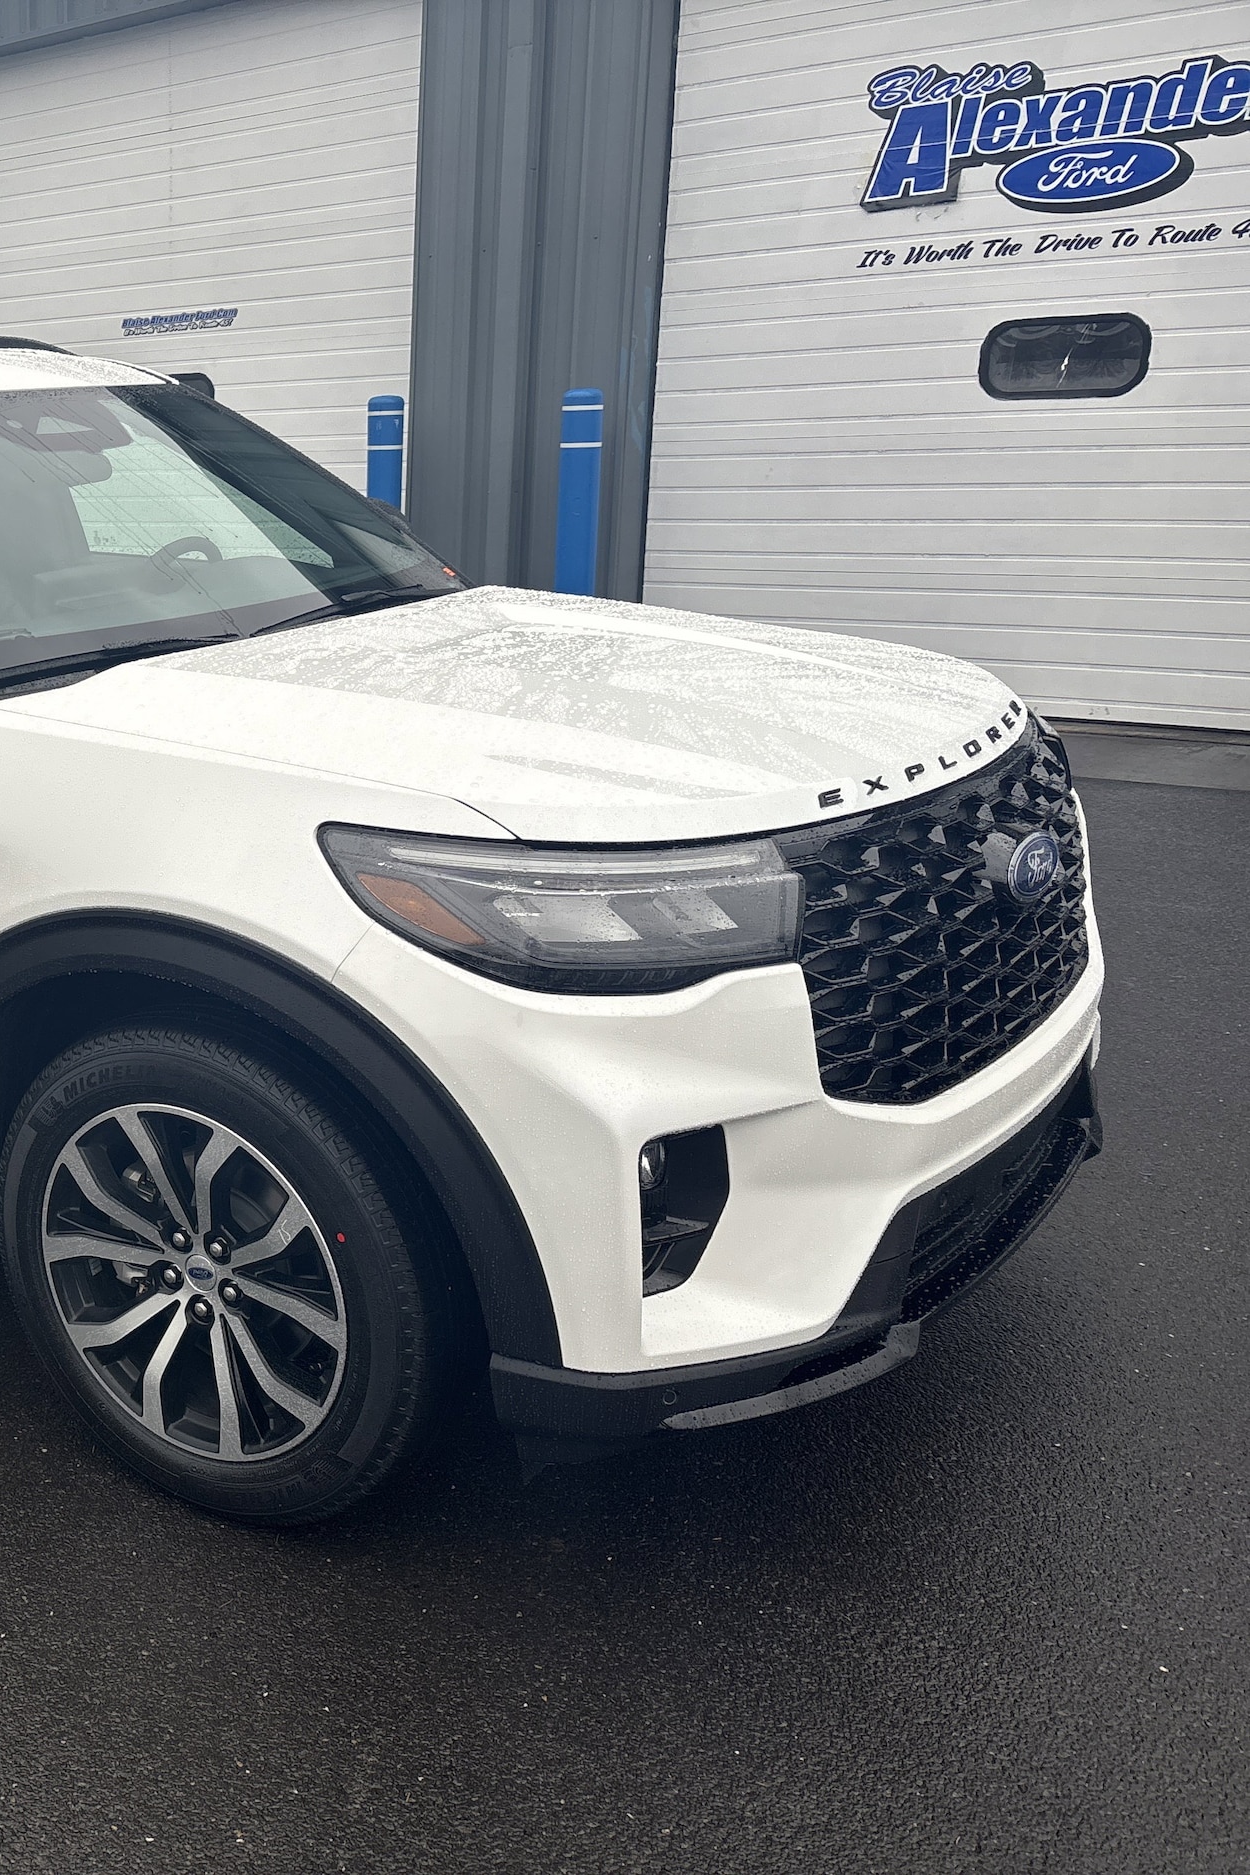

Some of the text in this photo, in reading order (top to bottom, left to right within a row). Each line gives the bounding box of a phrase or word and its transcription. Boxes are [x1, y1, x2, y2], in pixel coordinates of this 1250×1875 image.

[870, 64, 1033, 110] Blaise
[862, 57, 1250, 203] Alexande
[1037, 149, 1139, 192] Ford
[856, 218, 1250, 269] It's Worth The Drive To Route 4
[817, 699, 1023, 809] EXPLORER
[1027, 845, 1053, 888] Ford
